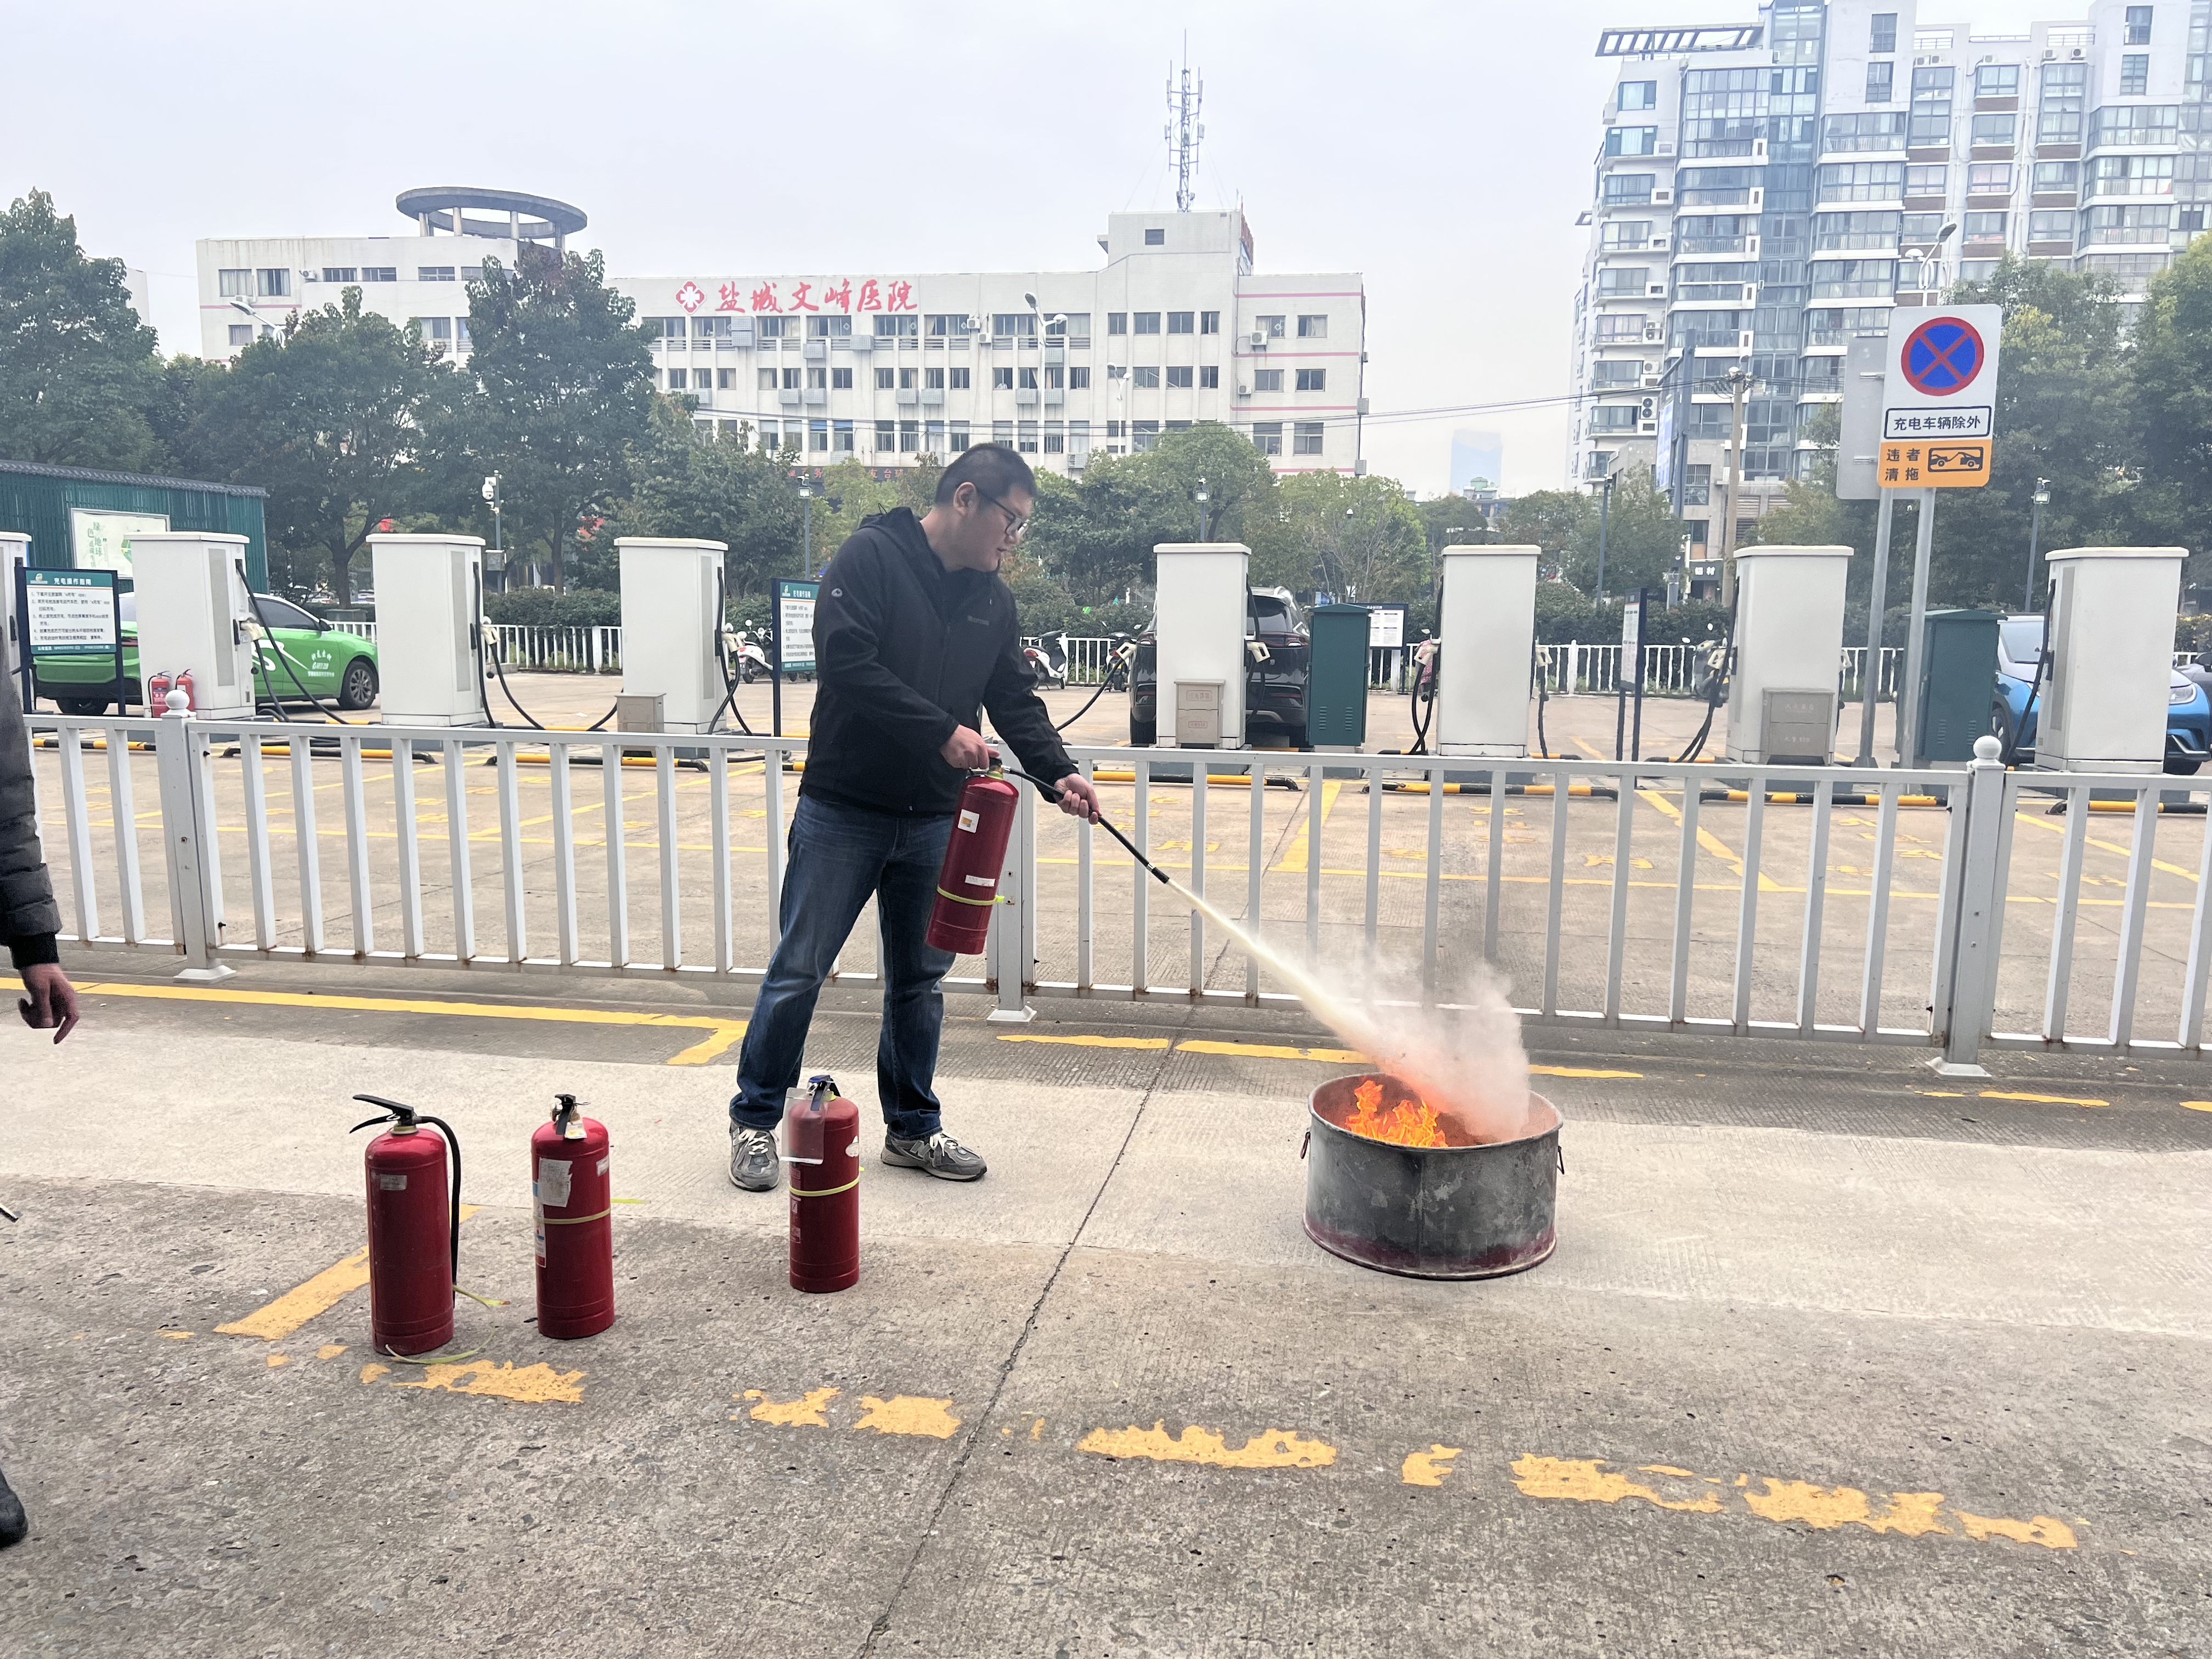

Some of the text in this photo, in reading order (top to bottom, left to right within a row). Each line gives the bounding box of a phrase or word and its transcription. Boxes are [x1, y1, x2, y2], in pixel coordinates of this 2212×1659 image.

[715, 278, 918, 314] 盐城文峰医院
[1893, 415, 1981, 431] 充电车辆除外
[1886, 448, 1921, 462] 违者
[1884, 467, 1920, 481] 清拖
